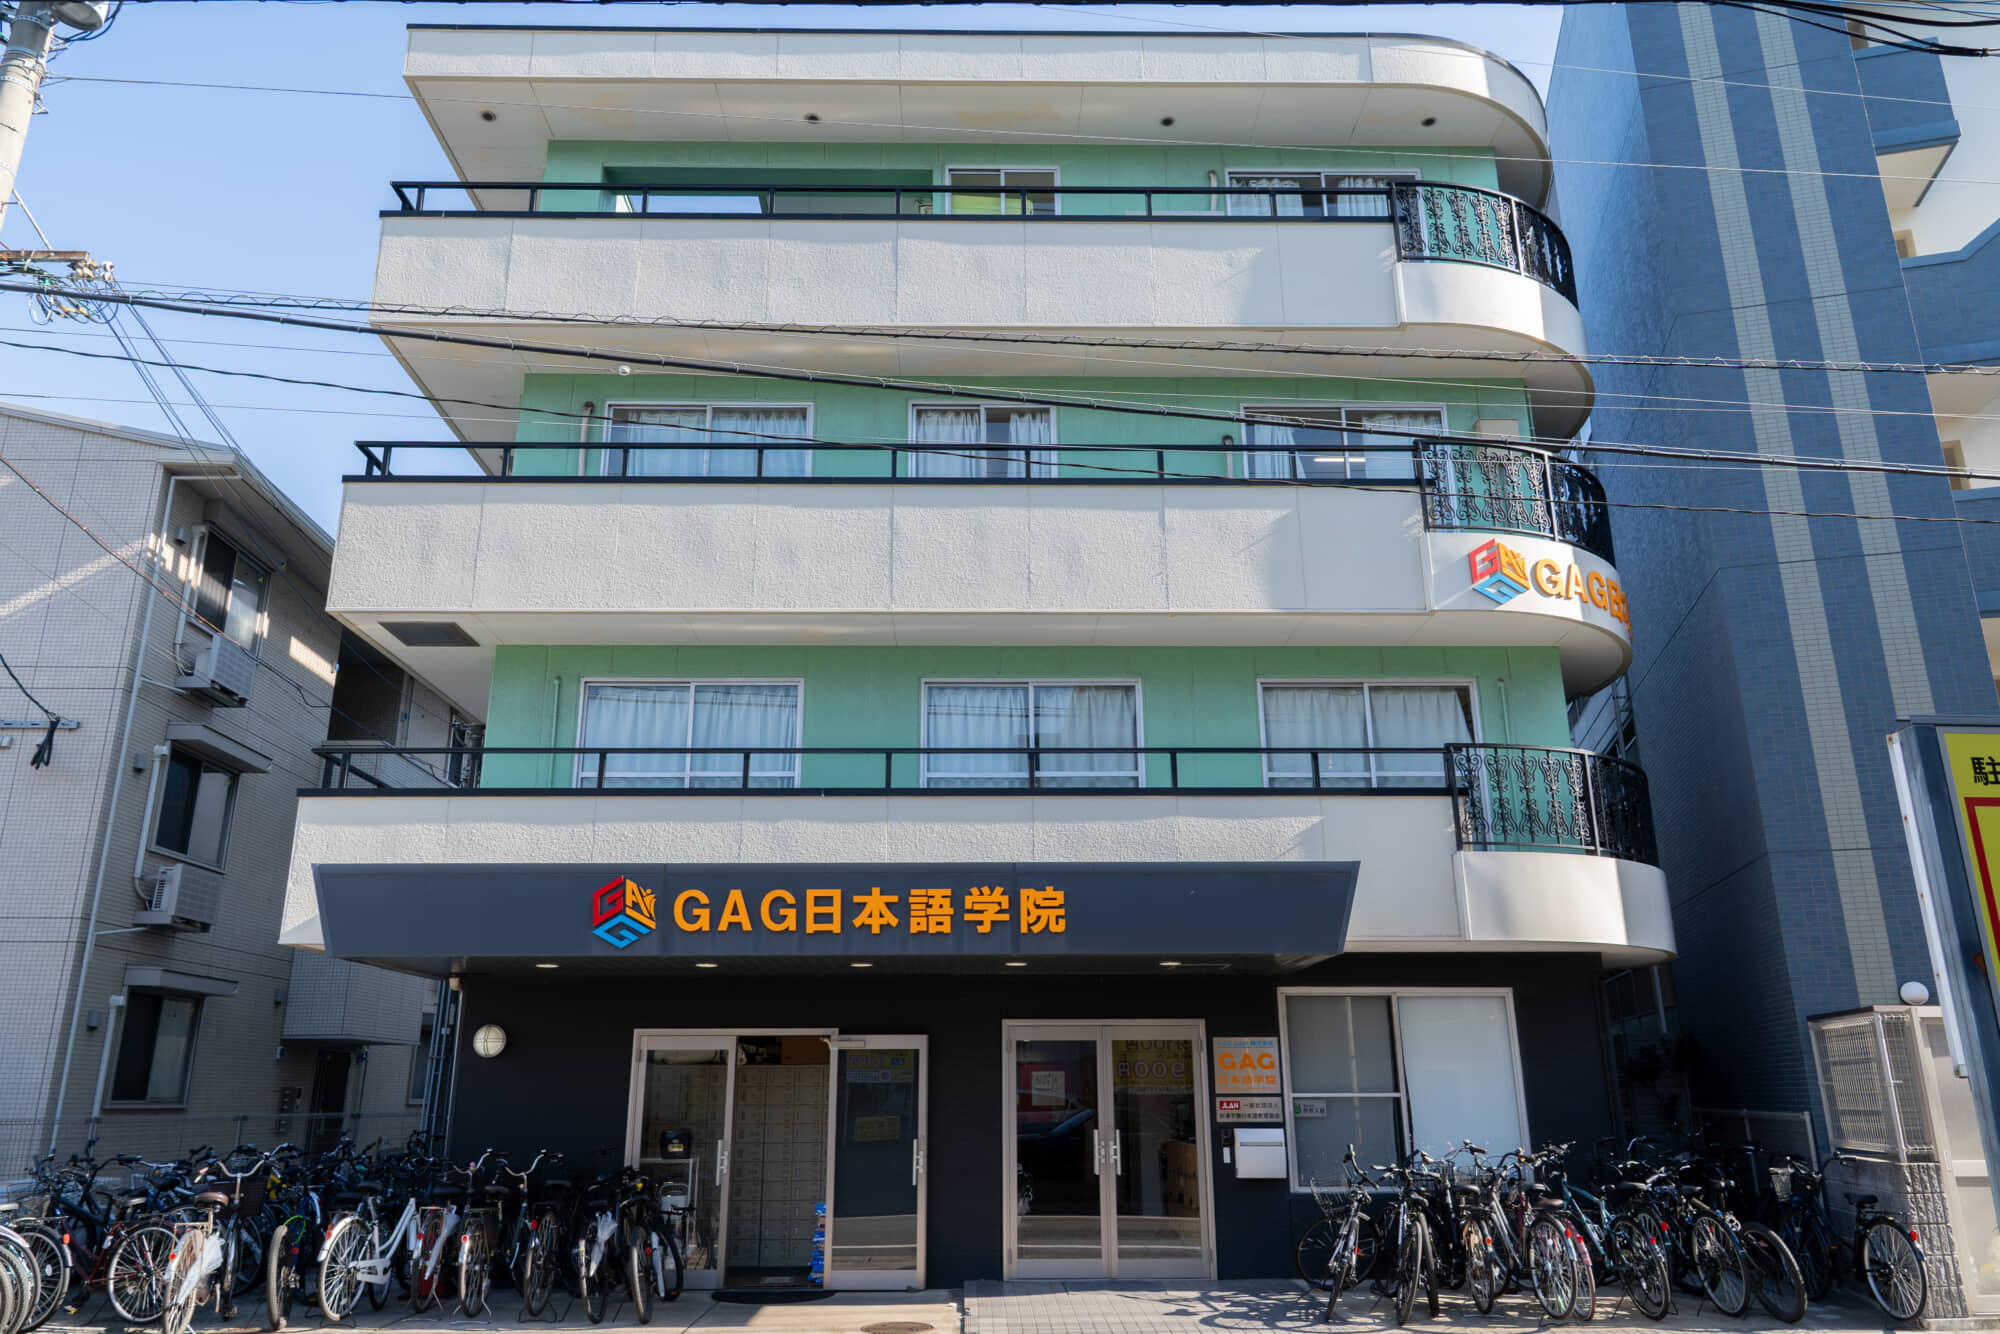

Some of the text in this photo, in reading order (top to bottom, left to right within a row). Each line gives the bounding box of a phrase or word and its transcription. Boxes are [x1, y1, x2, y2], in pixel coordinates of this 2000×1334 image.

[673, 886, 1066, 935] GAG日本語学院
[1218, 1052, 1275, 1070] GAG
